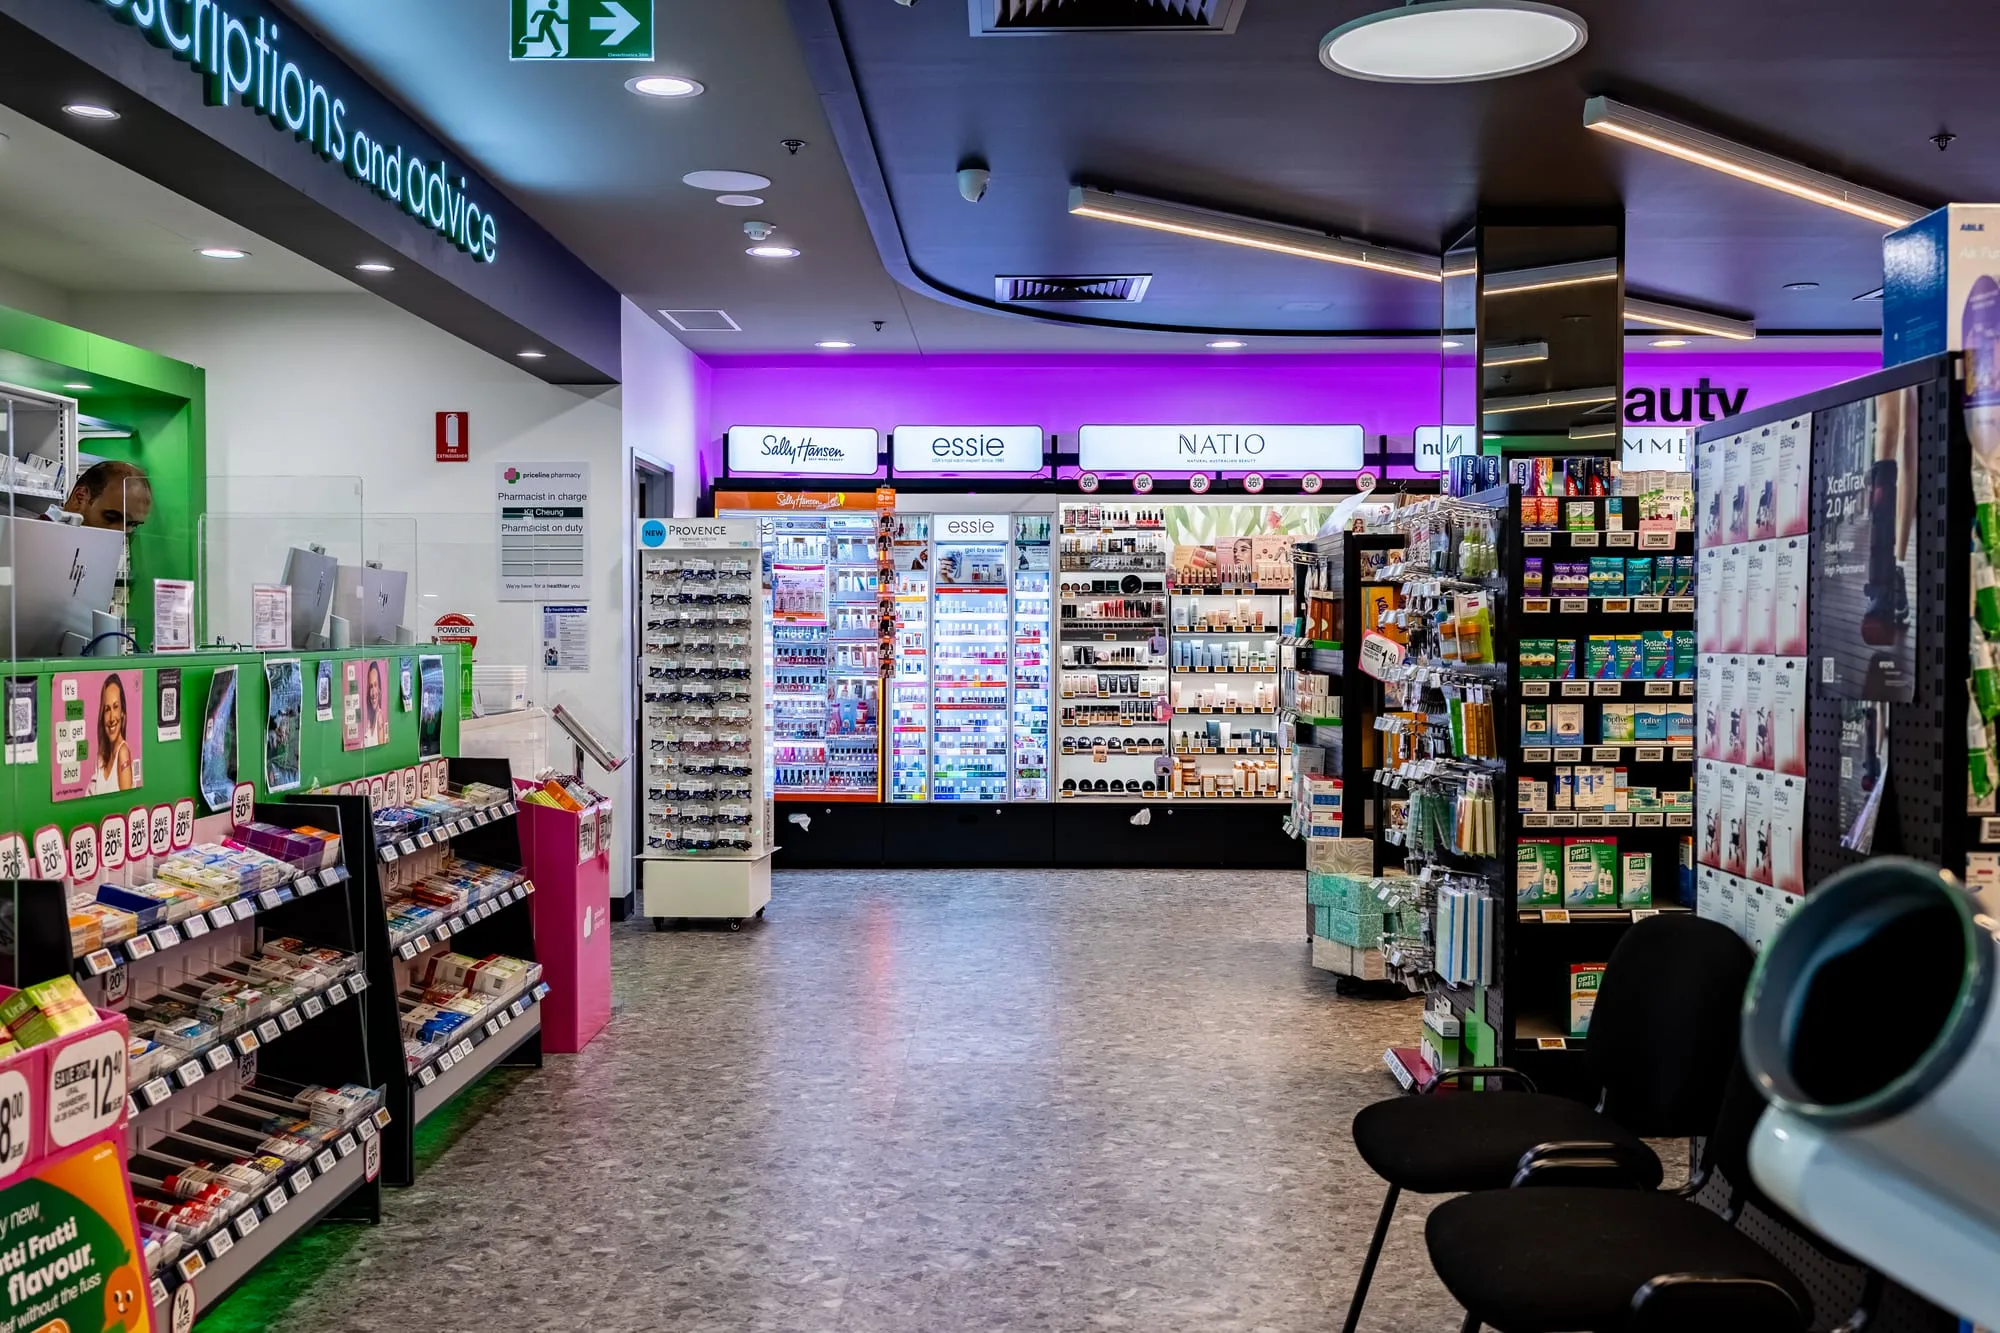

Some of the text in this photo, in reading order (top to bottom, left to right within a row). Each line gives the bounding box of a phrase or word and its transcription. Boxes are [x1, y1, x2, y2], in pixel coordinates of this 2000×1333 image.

[353, 131, 401, 201] and
[407, 157, 497, 263] advice
[761, 434, 845, 464] Sally Hansen
[932, 434, 1005, 457] essie
[1178, 433, 1265, 455] NATIO
[1082, 480, 1096, 488] 30%
[1137, 480, 1151, 488] 30%
[1193, 480, 1206, 488] 30%
[1247, 480, 1261, 488] 30%
[1827, 472, 1866, 495] XcelTrax
[497, 492, 587, 502] Pharmacist in charge
[776, 492, 795, 509] Sally
[535, 508, 564, 517] Cheung
[1825, 496, 1857, 518] 2.0 Air
[501, 524, 550, 532] Pharmacist
[564, 524, 584, 533] duty
[668, 525, 727, 536] PROVENCE
[948, 518, 994, 534] essie
[964, 547, 976, 555] gel
[976, 547, 986, 555] by
[437, 626, 470, 634] POWDER
[1644, 639, 1668, 649] Systane
[67, 706, 83, 717] time
[1606, 716, 1628, 724] optive
[1640, 716, 1661, 724] optive
[59, 727, 83, 738] to get
[59, 745, 87, 760] your flu
[63, 767, 78, 778] shot
[237, 793, 250, 805] SAVE
[177, 811, 190, 824] SAVE
[235, 802, 251, 818] 30%
[132, 818, 145, 831] SAVE
[155, 816, 168, 828] SAVE
[175, 821, 190, 837] 20%
[106, 827, 121, 840] SAVE
[131, 829, 146, 848] 20%
[153, 826, 169, 844] 20%
[41, 839, 58, 854] SAVE
[75, 837, 91, 851] SAVE
[104, 838, 123, 857] 20%
[1571, 847, 1589, 855] OPTI-
[42, 852, 62, 872] 20%
[74, 849, 94, 869] 20%
[109, 967, 125, 991] 20%
[1577, 974, 1595, 982] OPTI-
[31, 984, 61, 1004] Ural
[4, 998, 29, 1018] Ural
[56, 1061, 90, 1089] SAVE 20%
[91, 1055, 113, 1119] 12
[11, 1091, 23, 1119] 00
[57, 1092, 87, 1111] CRANBERRY
[28, 1216, 78, 1260] Frutti
[17, 1272, 102, 1329] without the fuss
